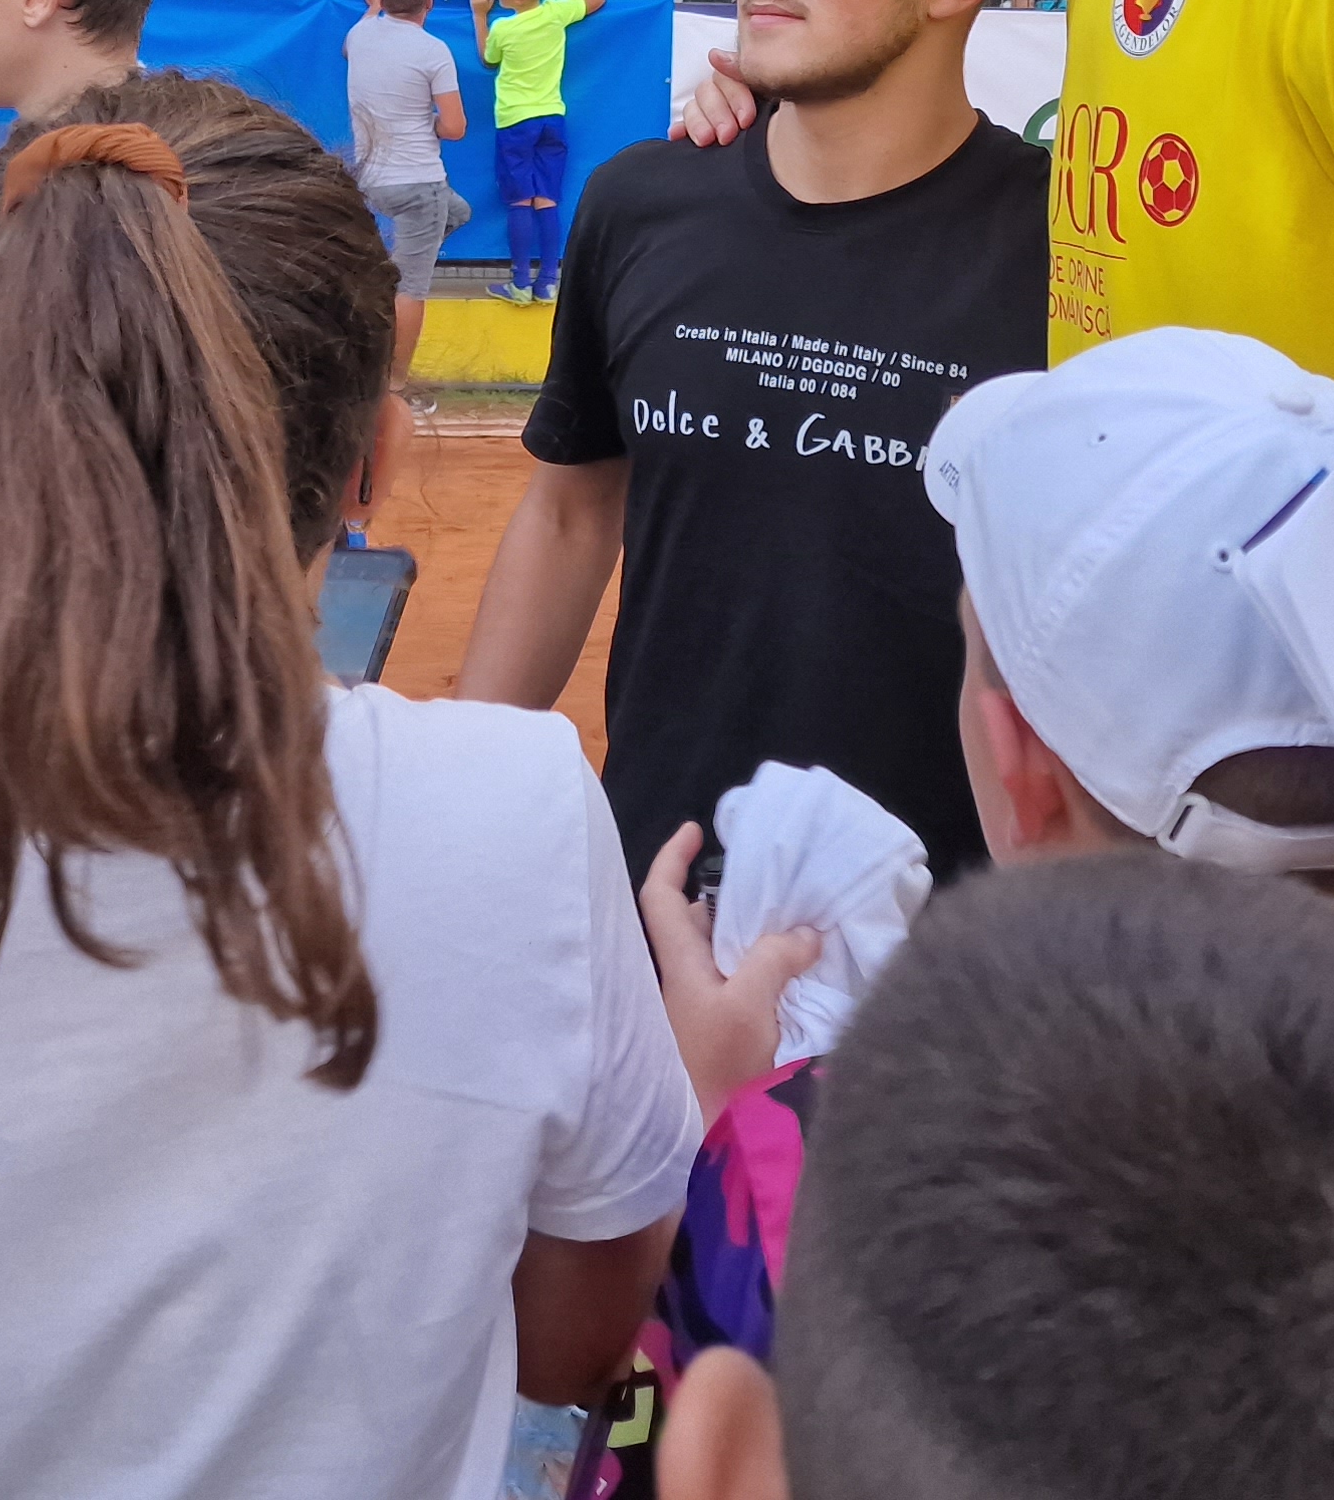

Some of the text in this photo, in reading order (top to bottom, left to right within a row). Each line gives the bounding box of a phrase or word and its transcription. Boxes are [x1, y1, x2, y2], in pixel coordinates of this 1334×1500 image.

[1114, 3, 1180, 52] LEGENDELOR
[675, 324, 720, 341] Creato
[723, 327, 737, 342] in
[741, 328, 778, 347] Italia
[791, 334, 829, 354] Made
[834, 341, 848, 357] in
[852, 344, 886, 367] Italy
[900, 353, 944, 375] Since
[949, 363, 968, 380] 84
[725, 347, 783, 368] MILANO
[801, 357, 867, 381] DGDGDG
[882, 371, 901, 388] 00
[758, 372, 795, 391] Italia
[799, 377, 817, 393] 00
[830, 382, 857, 400] 084
[633, 389, 720, 438] Dolce
[745, 417, 771, 449] &
